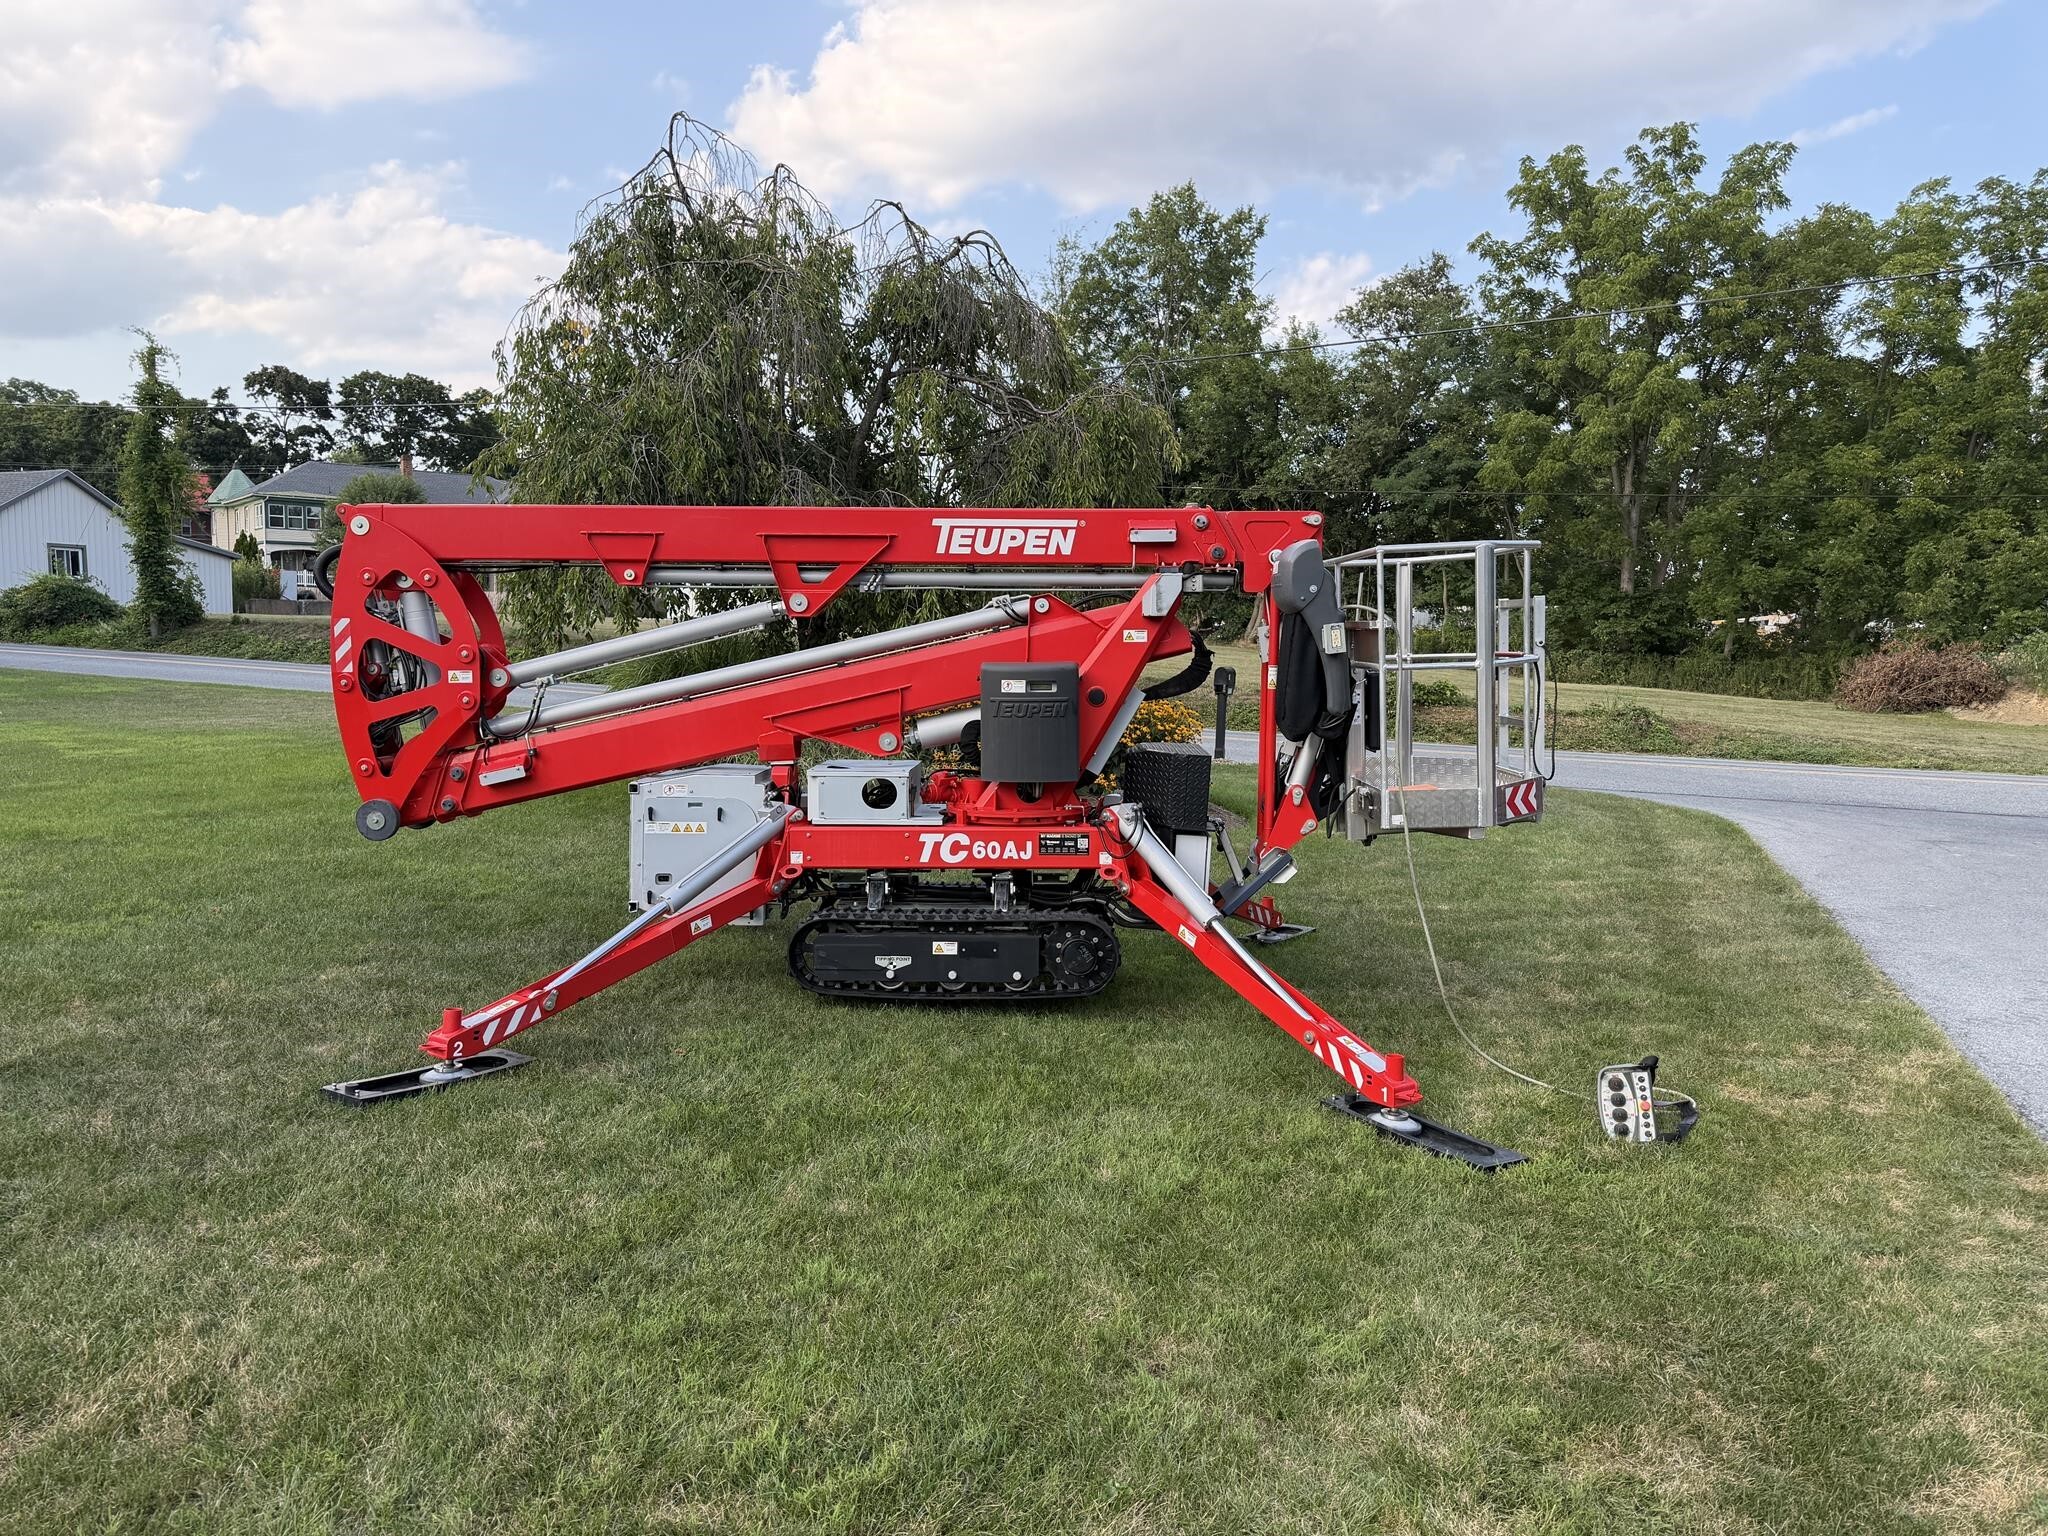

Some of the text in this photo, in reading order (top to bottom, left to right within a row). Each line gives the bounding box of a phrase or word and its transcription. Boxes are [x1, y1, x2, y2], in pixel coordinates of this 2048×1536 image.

[990, 697, 1069, 718] TEUPEN
[453, 1041, 463, 1056] 2
[1381, 1086, 1388, 1103] 1
